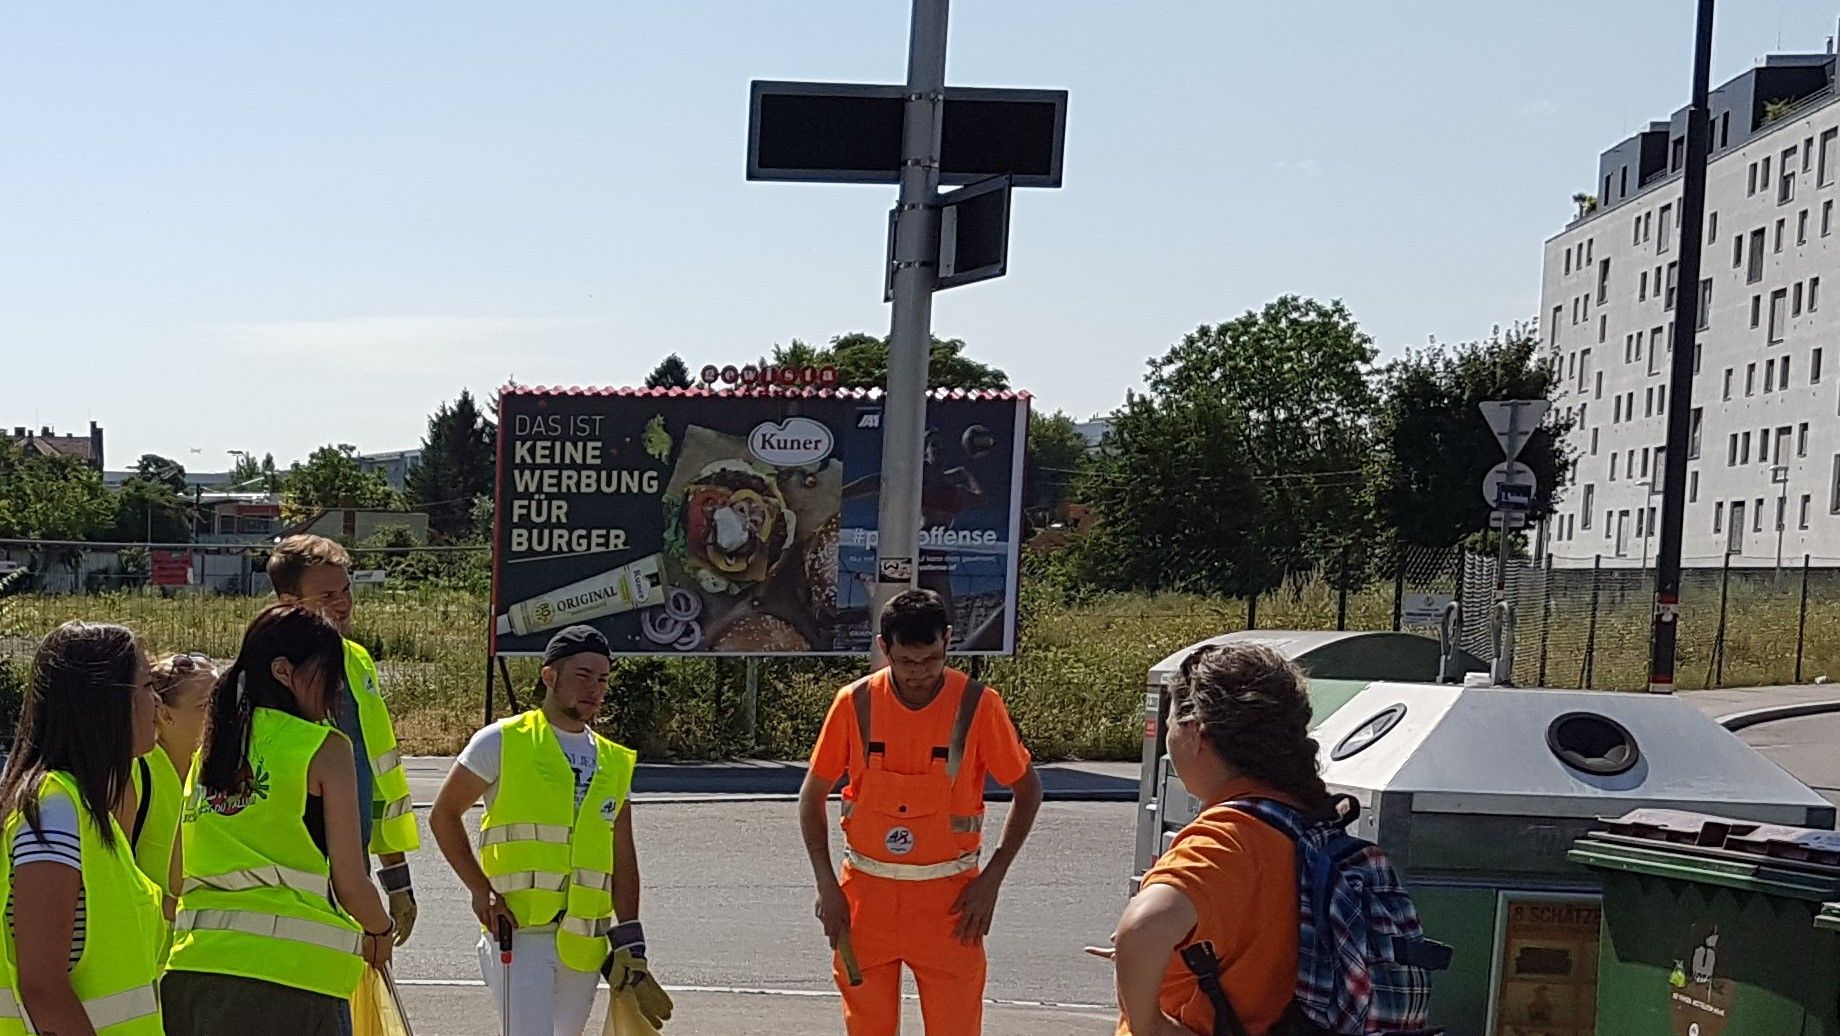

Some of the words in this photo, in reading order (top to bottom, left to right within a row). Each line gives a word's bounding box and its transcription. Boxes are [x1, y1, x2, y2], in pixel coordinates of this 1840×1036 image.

[704, 367, 834, 384] gewista
[515, 414, 561, 437] DAS
[569, 415, 605, 437] IST
[514, 440, 603, 465] KEINE
[760, 433, 823, 451] Kuner
[513, 469, 659, 494] WERBUNG
[512, 493, 568, 524] FÜR
[511, 528, 627, 552] BURGER
[556, 585, 618, 613] ORIGINAL
